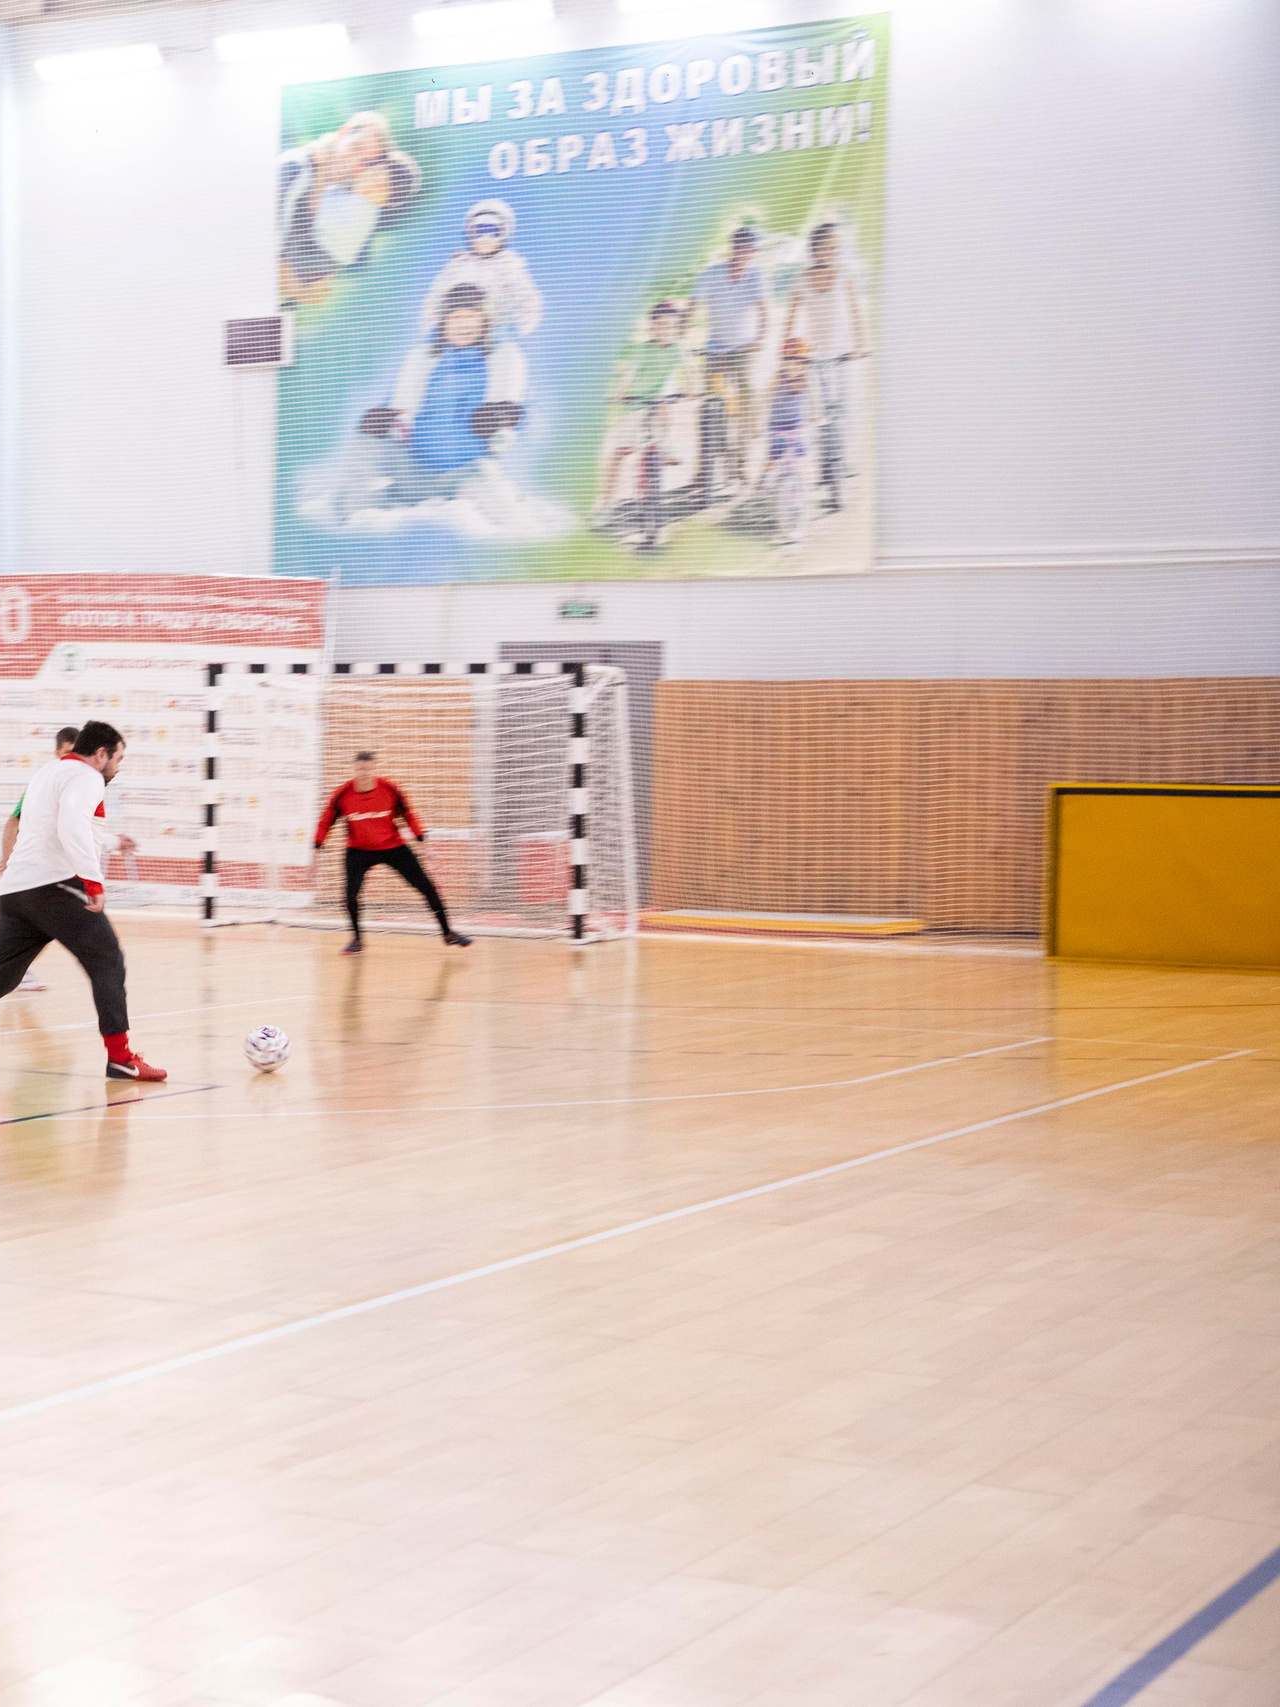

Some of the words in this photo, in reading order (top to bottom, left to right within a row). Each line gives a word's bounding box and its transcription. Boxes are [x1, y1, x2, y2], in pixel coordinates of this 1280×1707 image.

[414, 84, 493, 129] МЫ
[505, 76, 566, 119] ЗА
[582, 29, 877, 117] ЗДОРОВЫЙ
[487, 127, 650, 180] ОБРАЗ
[662, 100, 873, 166] ЖИЗНИ!
